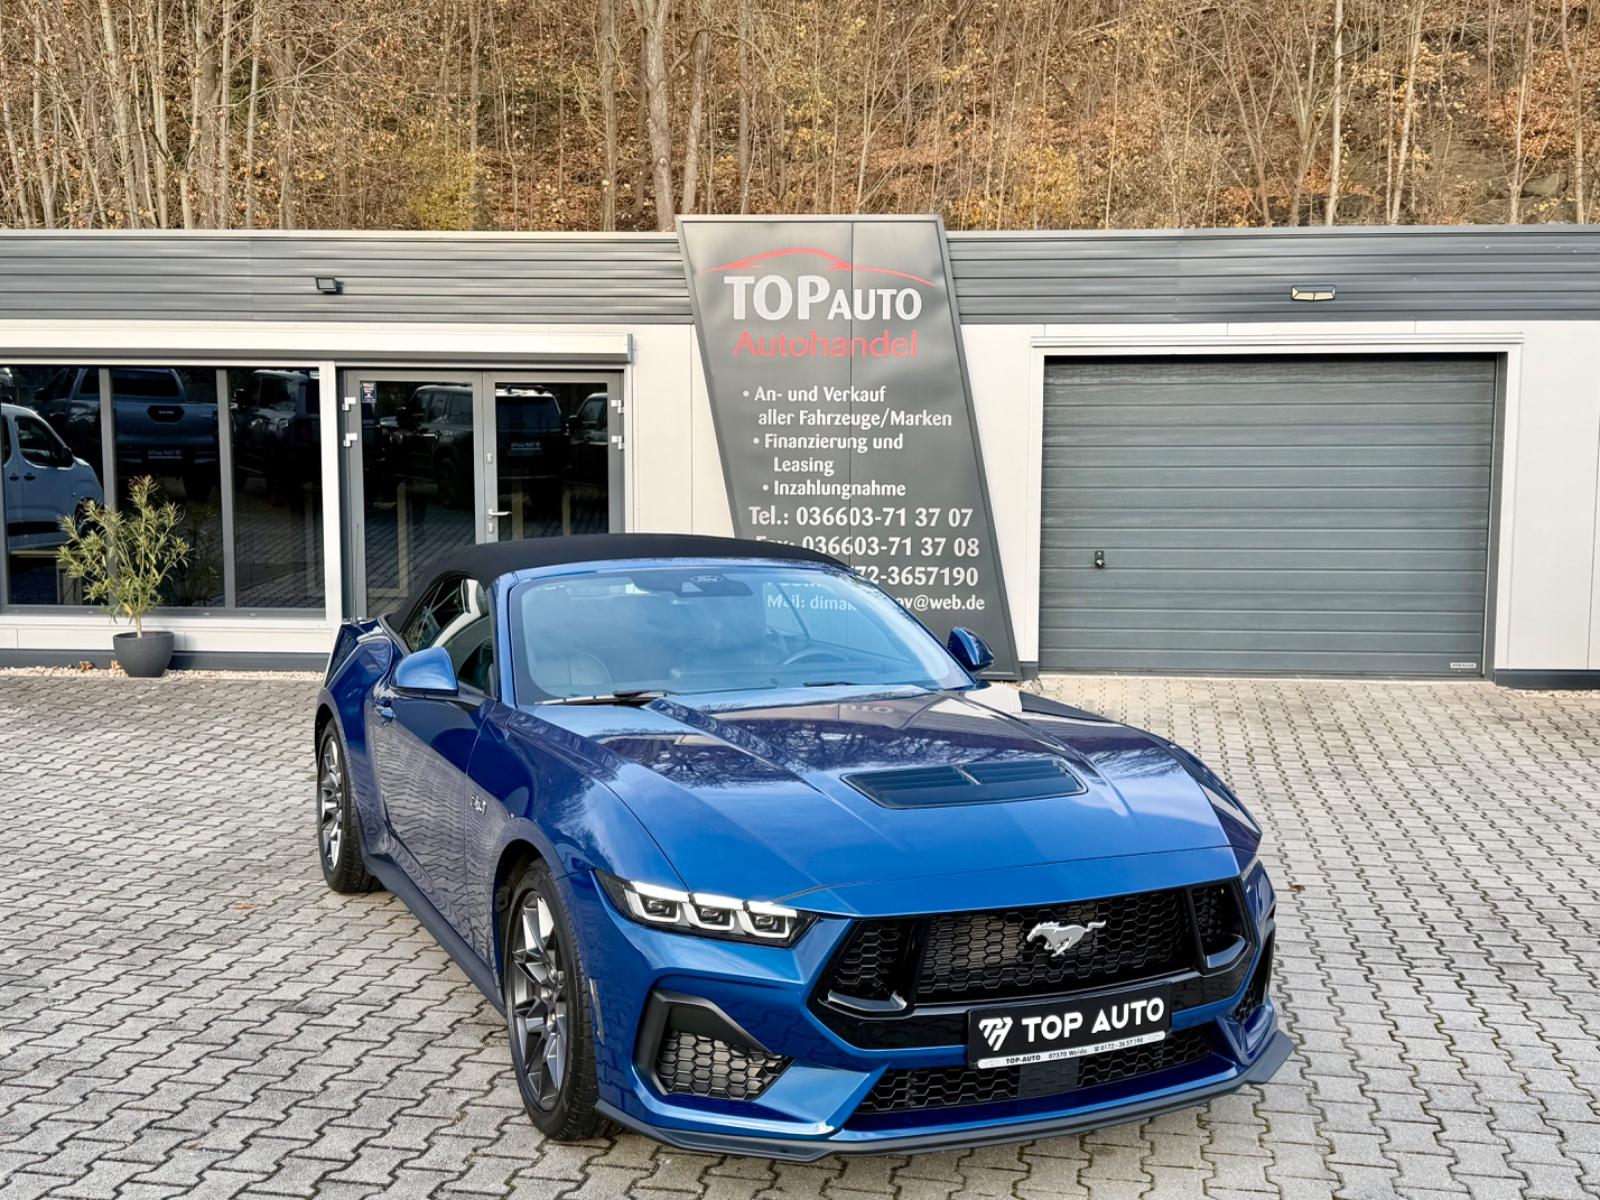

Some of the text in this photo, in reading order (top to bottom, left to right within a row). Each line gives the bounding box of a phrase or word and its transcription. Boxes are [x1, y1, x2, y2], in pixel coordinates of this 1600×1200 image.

[732, 329, 918, 358] Autohandel
[754, 386, 886, 402] An- und Verkauf
[758, 408, 952, 430] aller Fahrzeuge/Marken
[764, 433, 904, 453] Finanzierung und
[773, 457, 834, 476] Leasing
[774, 480, 906, 499] Inzahlungnahme
[748, 506, 974, 528] Tel.: 036603-71 37 07
[920, 537, 947, 557] 37
[953, 538, 980, 557] 08
[855, 566, 979, 587] 72-3657190
[1021, 997, 1165, 1043] TOP AUTO
[1006, 1054, 1041, 1065] TOP-AUTO
